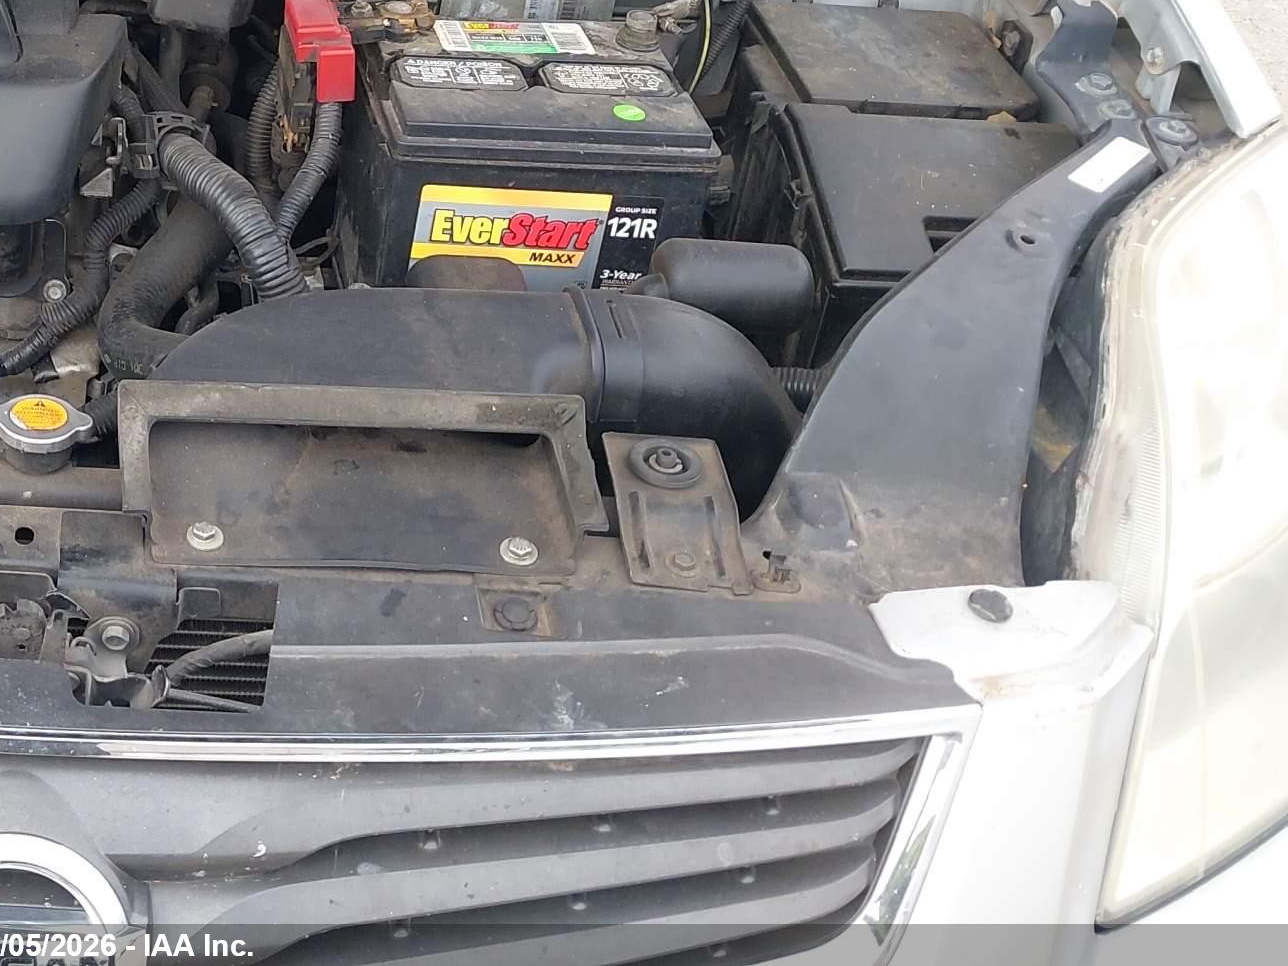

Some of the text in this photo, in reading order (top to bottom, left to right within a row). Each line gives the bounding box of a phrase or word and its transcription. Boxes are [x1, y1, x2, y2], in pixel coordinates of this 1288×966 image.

[615, 206, 657, 215] GROUP SIZE
[429, 208, 600, 251] EverStart
[607, 216, 659, 240] 121R
[528, 251, 576, 264] MAXX
[599, 268, 643, 281] 3-Year
